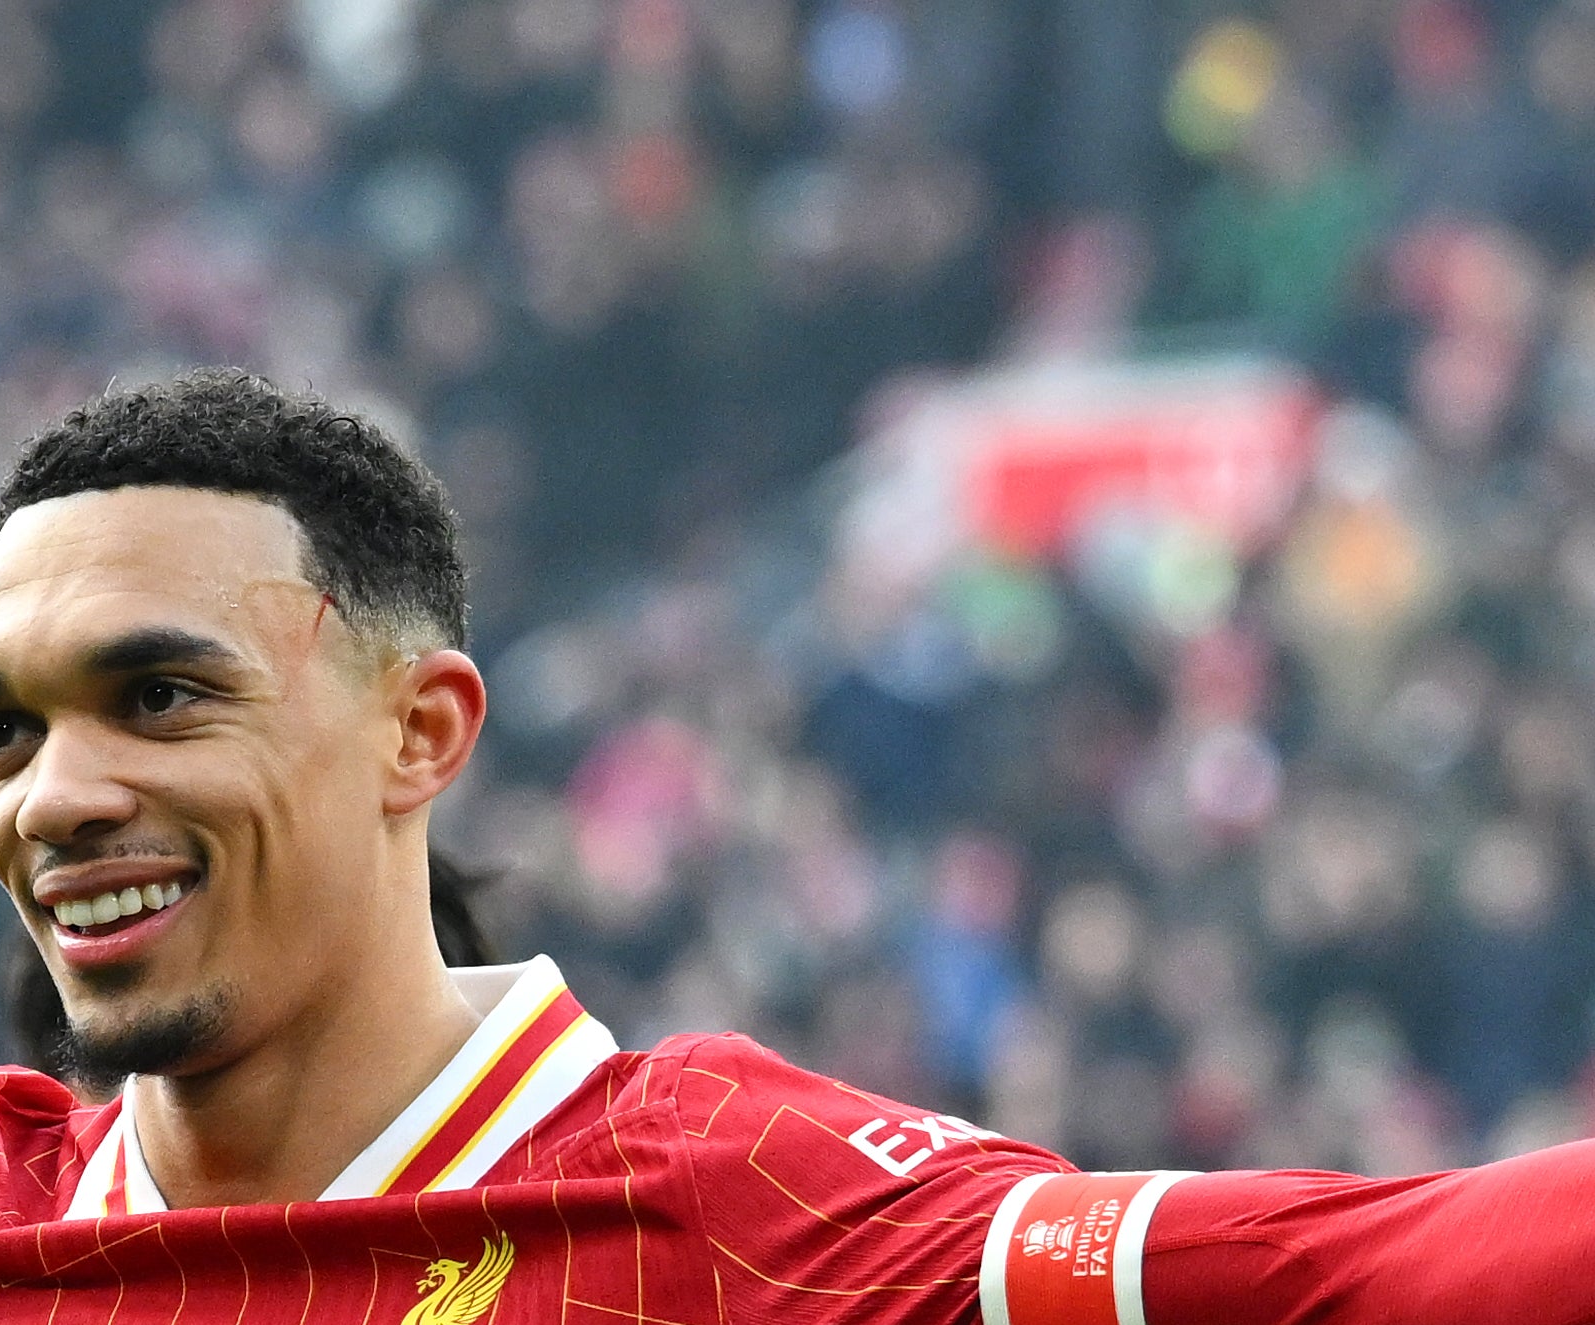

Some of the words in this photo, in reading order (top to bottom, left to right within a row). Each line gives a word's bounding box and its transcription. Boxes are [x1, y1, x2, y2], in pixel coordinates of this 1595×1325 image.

[1072, 1199, 1106, 1277] Emirates
[1094, 1198, 1122, 1244] CUP
[1090, 1246, 1110, 1277] FA
